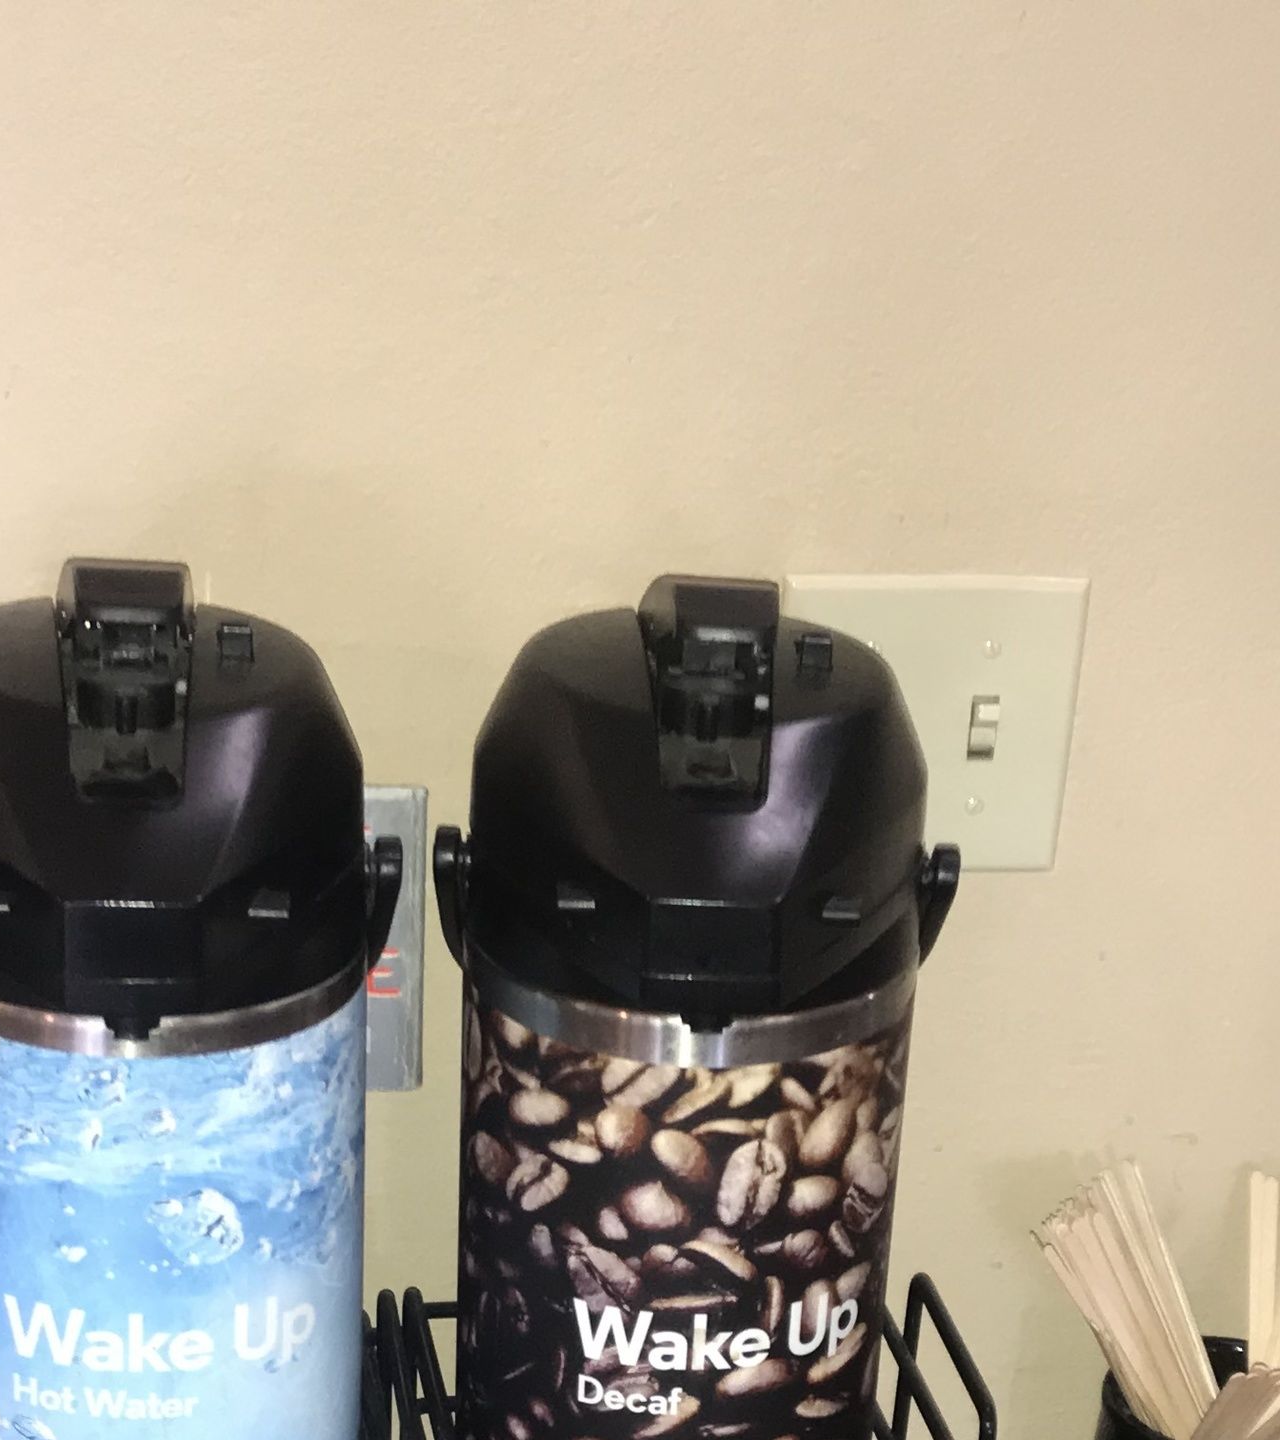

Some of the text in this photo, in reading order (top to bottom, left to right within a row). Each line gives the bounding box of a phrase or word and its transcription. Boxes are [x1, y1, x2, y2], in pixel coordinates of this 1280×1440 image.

[3, 1293, 316, 1373] Wake Up
[573, 1291, 859, 1371] Wake Up
[11, 1372, 200, 1421] Hot Water
[577, 1374, 683, 1416] Decaf
